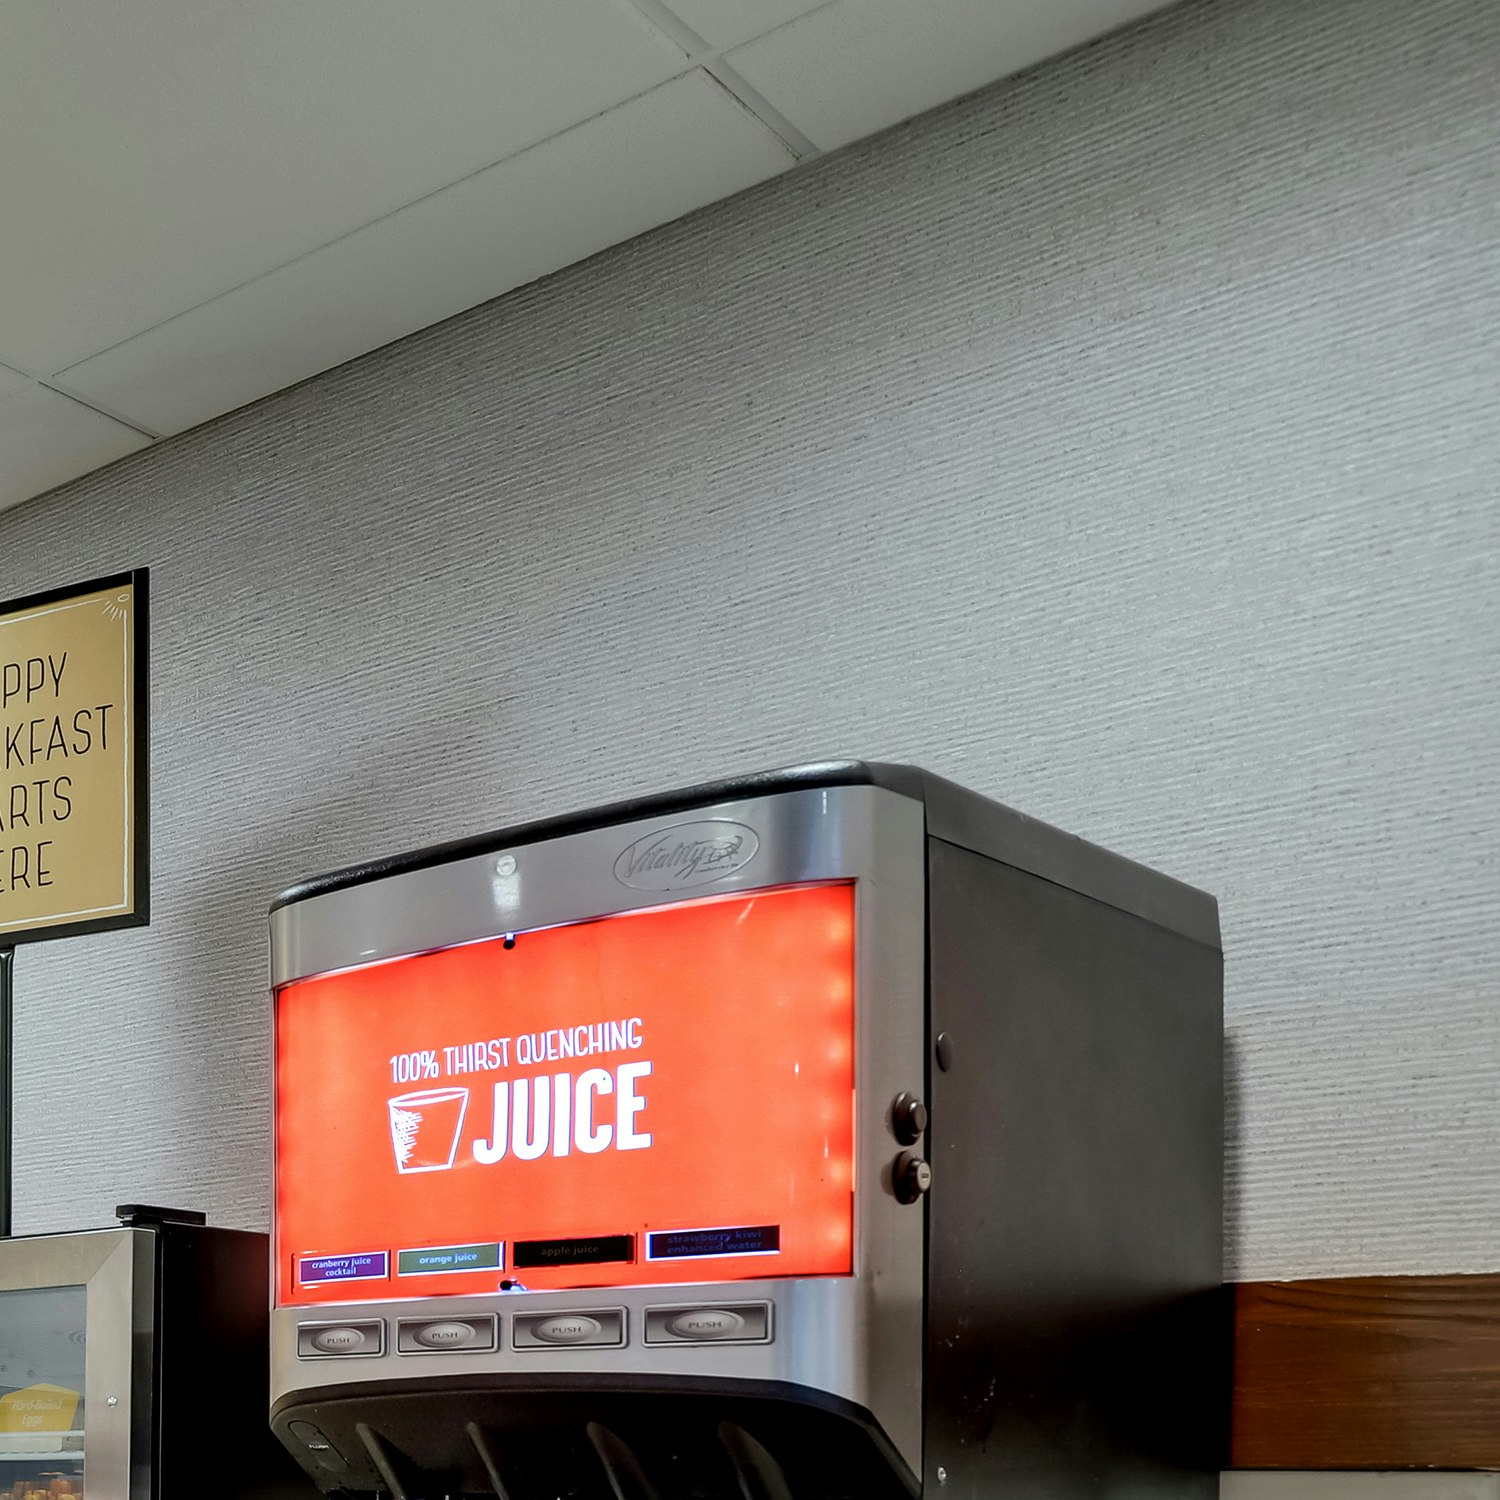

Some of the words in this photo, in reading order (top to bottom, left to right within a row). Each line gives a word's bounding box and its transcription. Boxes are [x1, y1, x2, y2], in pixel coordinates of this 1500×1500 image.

[389, 1050, 440, 1084] 100%
[443, 1037, 511, 1076] THIRST
[516, 1017, 644, 1066] QUENCHING
[472, 1060, 652, 1165] JUICE
[667, 1231, 732, 1245] strawberry
[735, 1229, 762, 1240] kiwi
[541, 1246, 570, 1258] apple
[572, 1244, 599, 1256] juice
[667, 1242, 724, 1254] enhanced
[727, 1240, 762, 1250] water
[311, 1259, 350, 1270] cranberry
[350, 1256, 372, 1267] juice
[419, 1255, 453, 1266] orange
[453, 1252, 478, 1264] juice
[325, 1266, 357, 1277] cocktail
[552, 1326, 582, 1334] PUSH
[688, 1320, 722, 1329] PUSH
[327, 1337, 350, 1345] PUSH
[431, 1331, 458, 1339] PUSH
